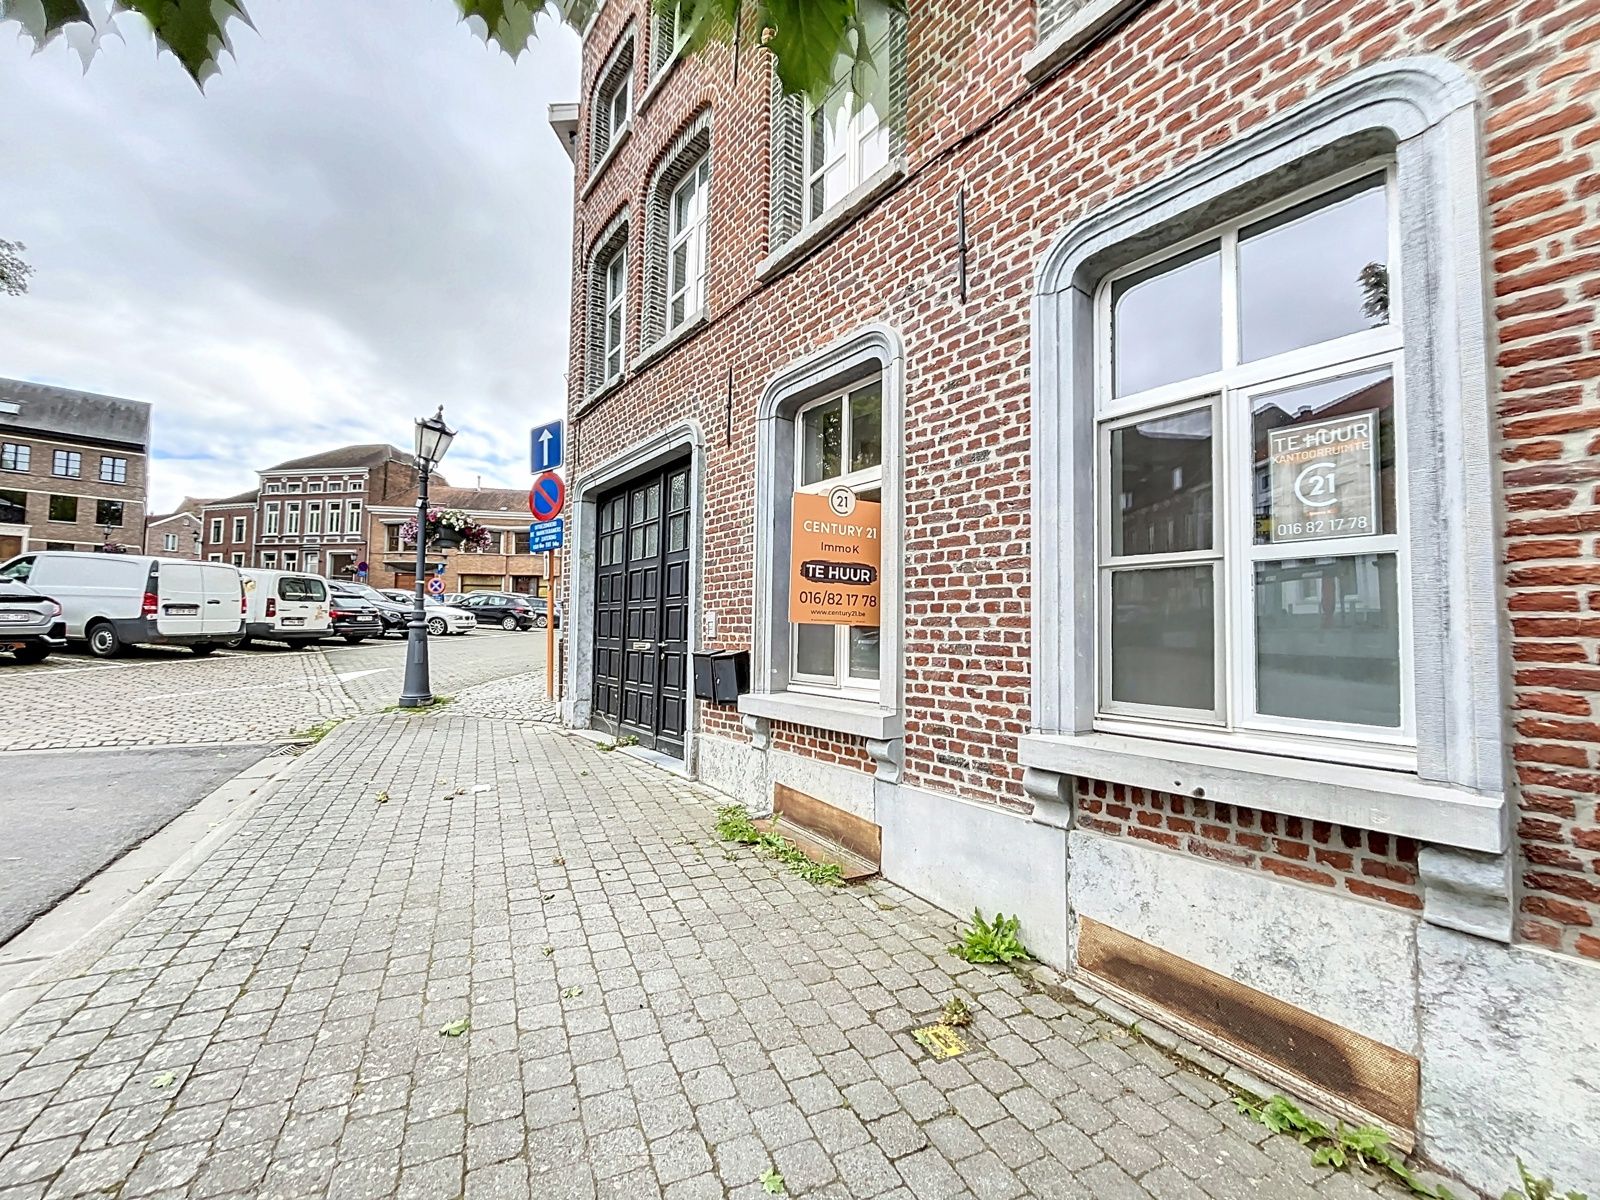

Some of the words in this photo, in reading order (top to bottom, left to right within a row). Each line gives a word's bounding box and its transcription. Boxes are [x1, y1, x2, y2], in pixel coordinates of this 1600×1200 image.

[1274, 435, 1300, 453] TE
[1306, 423, 1368, 448] HUUR
[1273, 441, 1371, 464] KANTOORRUIMTE
[803, 520, 863, 537] CENTURY
[866, 527, 877, 539] 21
[1277, 522, 1302, 536] 016
[1306, 520, 1324, 534] 82
[1329, 518, 1344, 531] 17
[1348, 516, 1368, 529] 78
[806, 564, 825, 578] TE
[828, 566, 871, 582] HUUR
[799, 590, 843, 606] 016/82
[846, 593, 858, 606] 17
[861, 594, 877, 608] 78
[810, 609, 866, 617] www.century21.be
